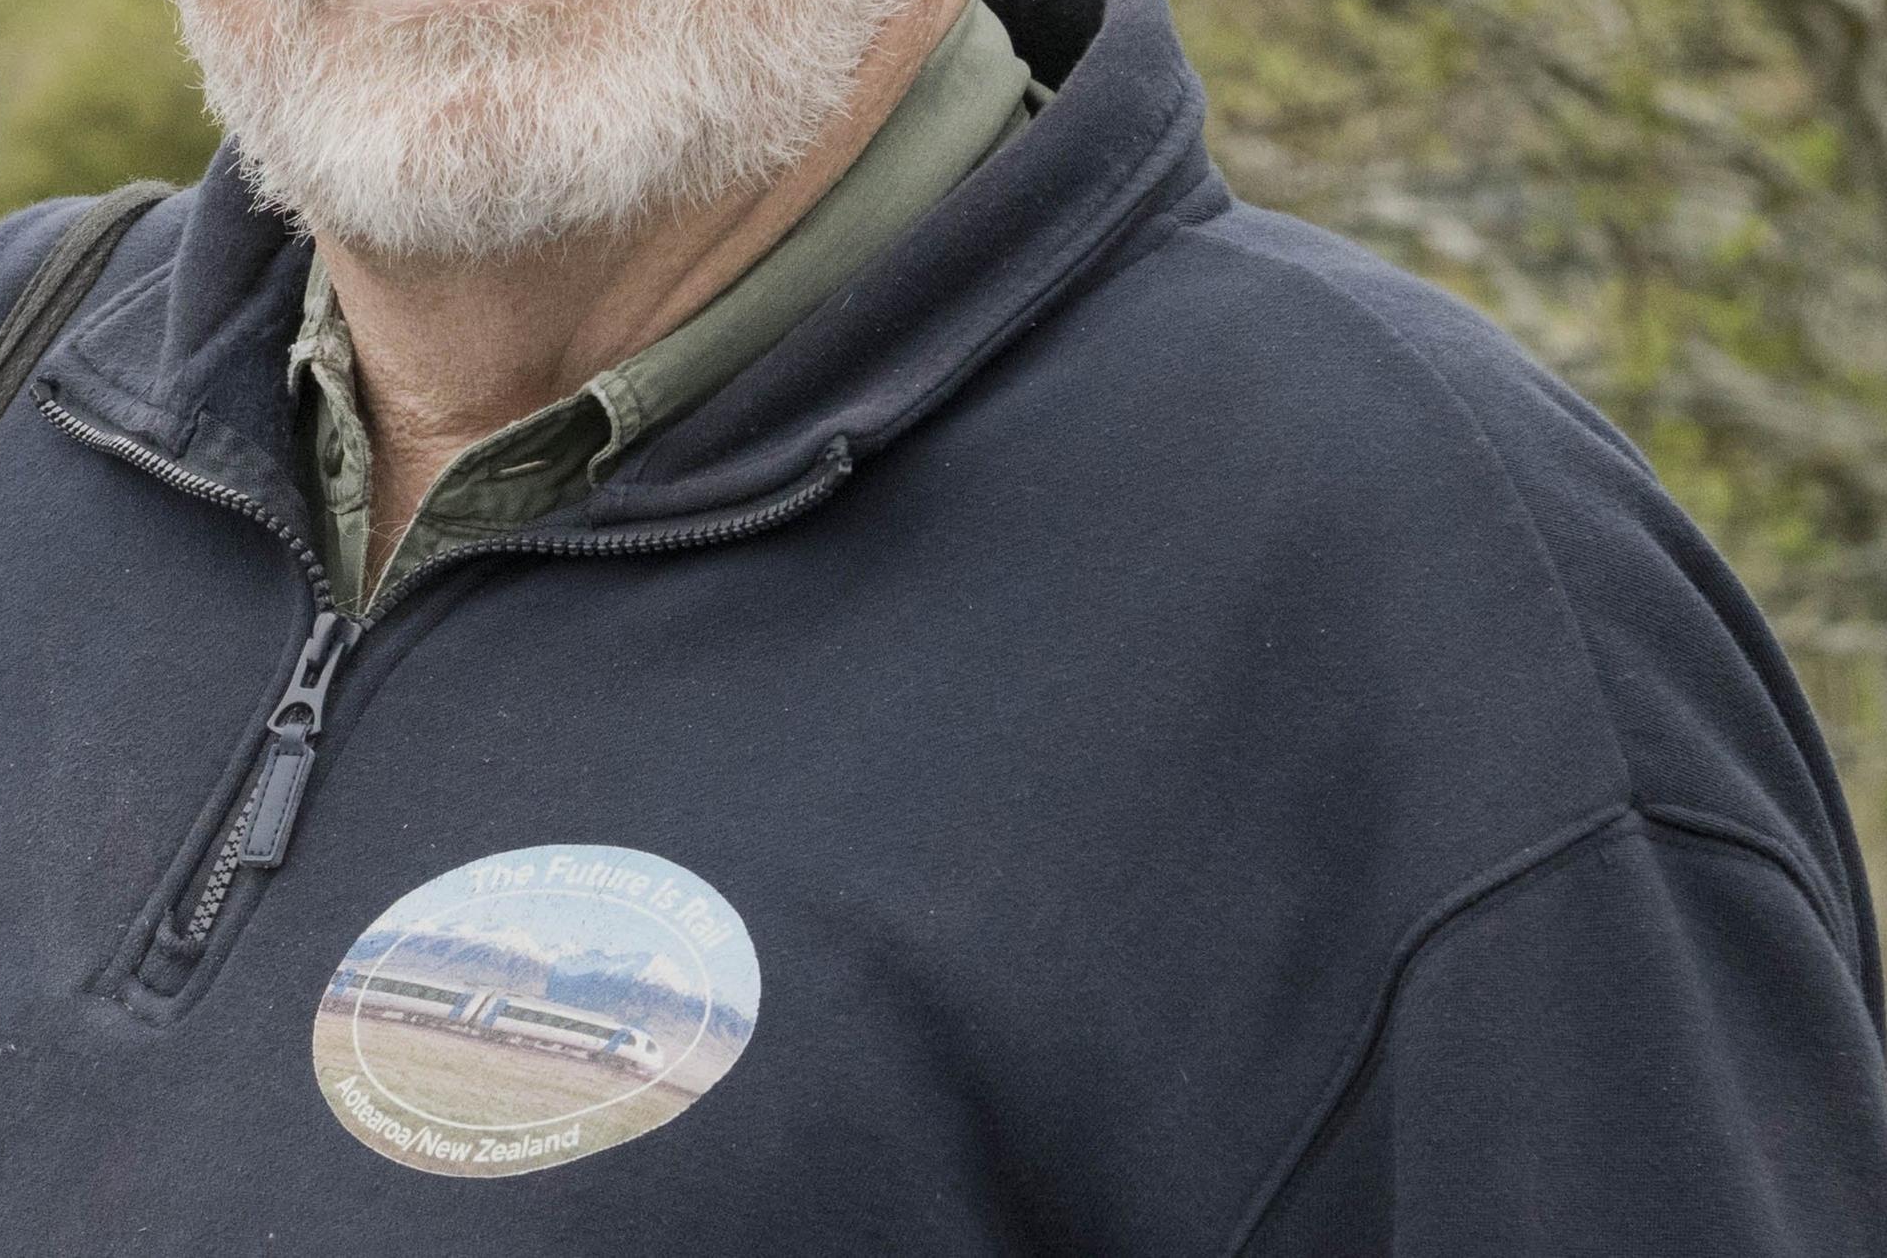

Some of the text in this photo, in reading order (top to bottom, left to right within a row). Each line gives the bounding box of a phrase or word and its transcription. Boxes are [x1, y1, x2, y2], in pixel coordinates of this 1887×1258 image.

[470, 863, 535, 893] The
[545, 854, 652, 896] Future
[674, 896, 734, 949] Rail
[336, 1074, 581, 1163] Aotearoa/New Zealand
